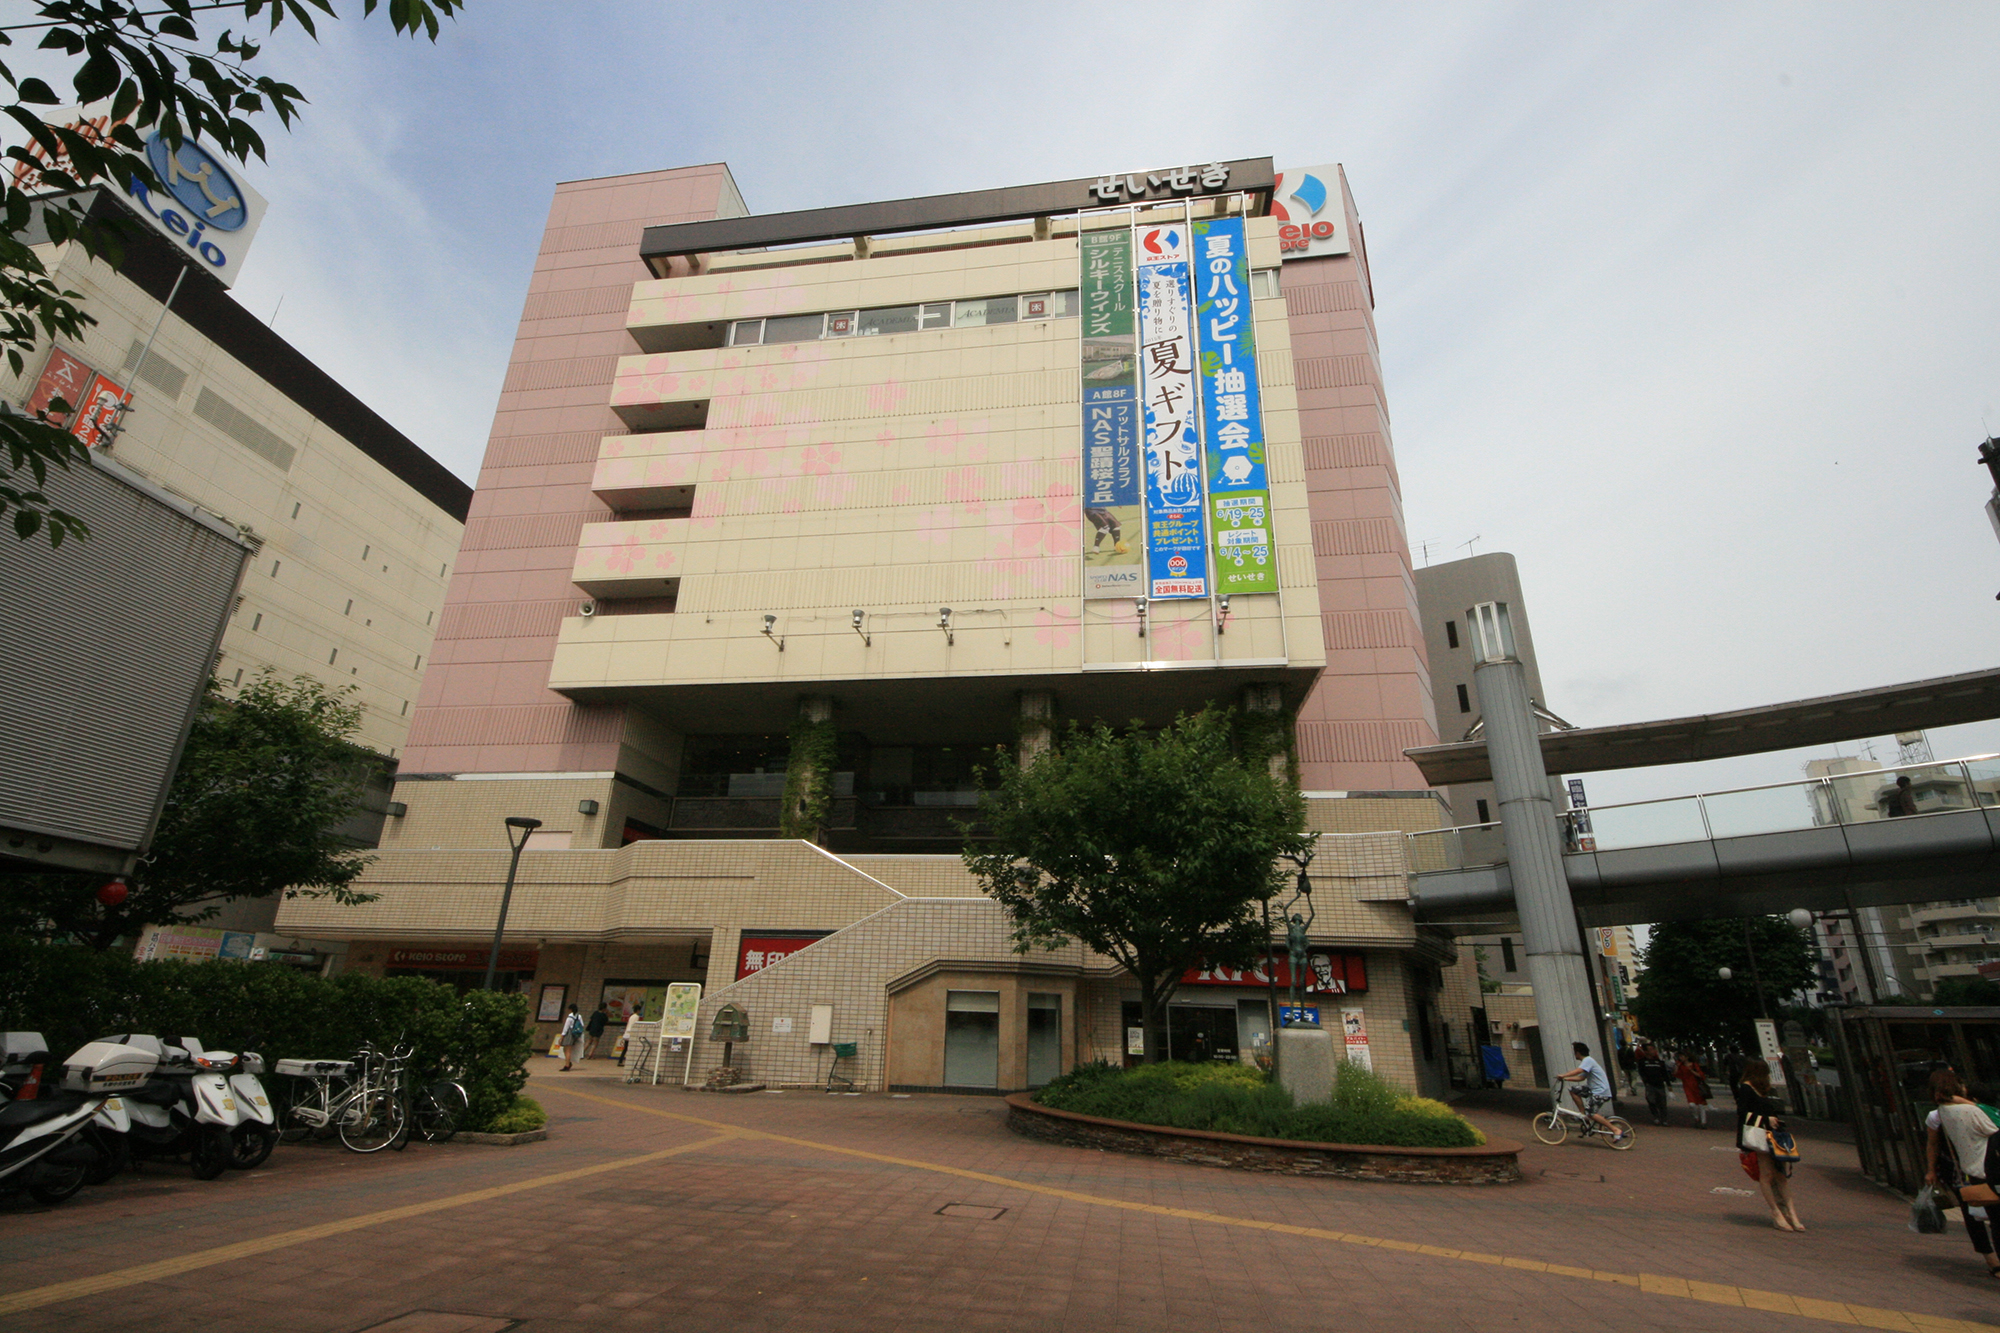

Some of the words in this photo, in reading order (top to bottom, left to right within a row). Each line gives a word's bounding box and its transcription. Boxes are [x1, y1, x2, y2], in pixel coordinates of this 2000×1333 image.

[1089, 162, 1230, 198] せいせき
[1279, 221, 1335, 241] eio
[1091, 234, 1122, 244] B館9F
[1280, 239, 1310, 251] ore
[1146, 254, 1180, 262] 京王ストア
[1112, 247, 1126, 311] テニススクール
[1152, 281, 1163, 334] 夏を贈り物に
[1165, 279, 1178, 333] 選りすぐりの
[958, 307, 1015, 320] ACADEMIA
[1205, 234, 1250, 450] 夏のハッピー抽選会
[1092, 389, 1127, 399] A館8F
[1141, 335, 1193, 481] 夏ギフト
[1116, 405, 1131, 489] フットサルクラブ
[1222, 498, 1256, 507] 抽選期間
[1152, 520, 1199, 529] 京王グループ
[1228, 530, 1257, 538] レシート
[1227, 536, 1259, 545] 対象期間
[1108, 573, 1138, 581] NAS
[1228, 572, 1265, 582] せいせき
[1155, 585, 1203, 594] 全国無料配送
[744, 949, 802, 971] 無印
